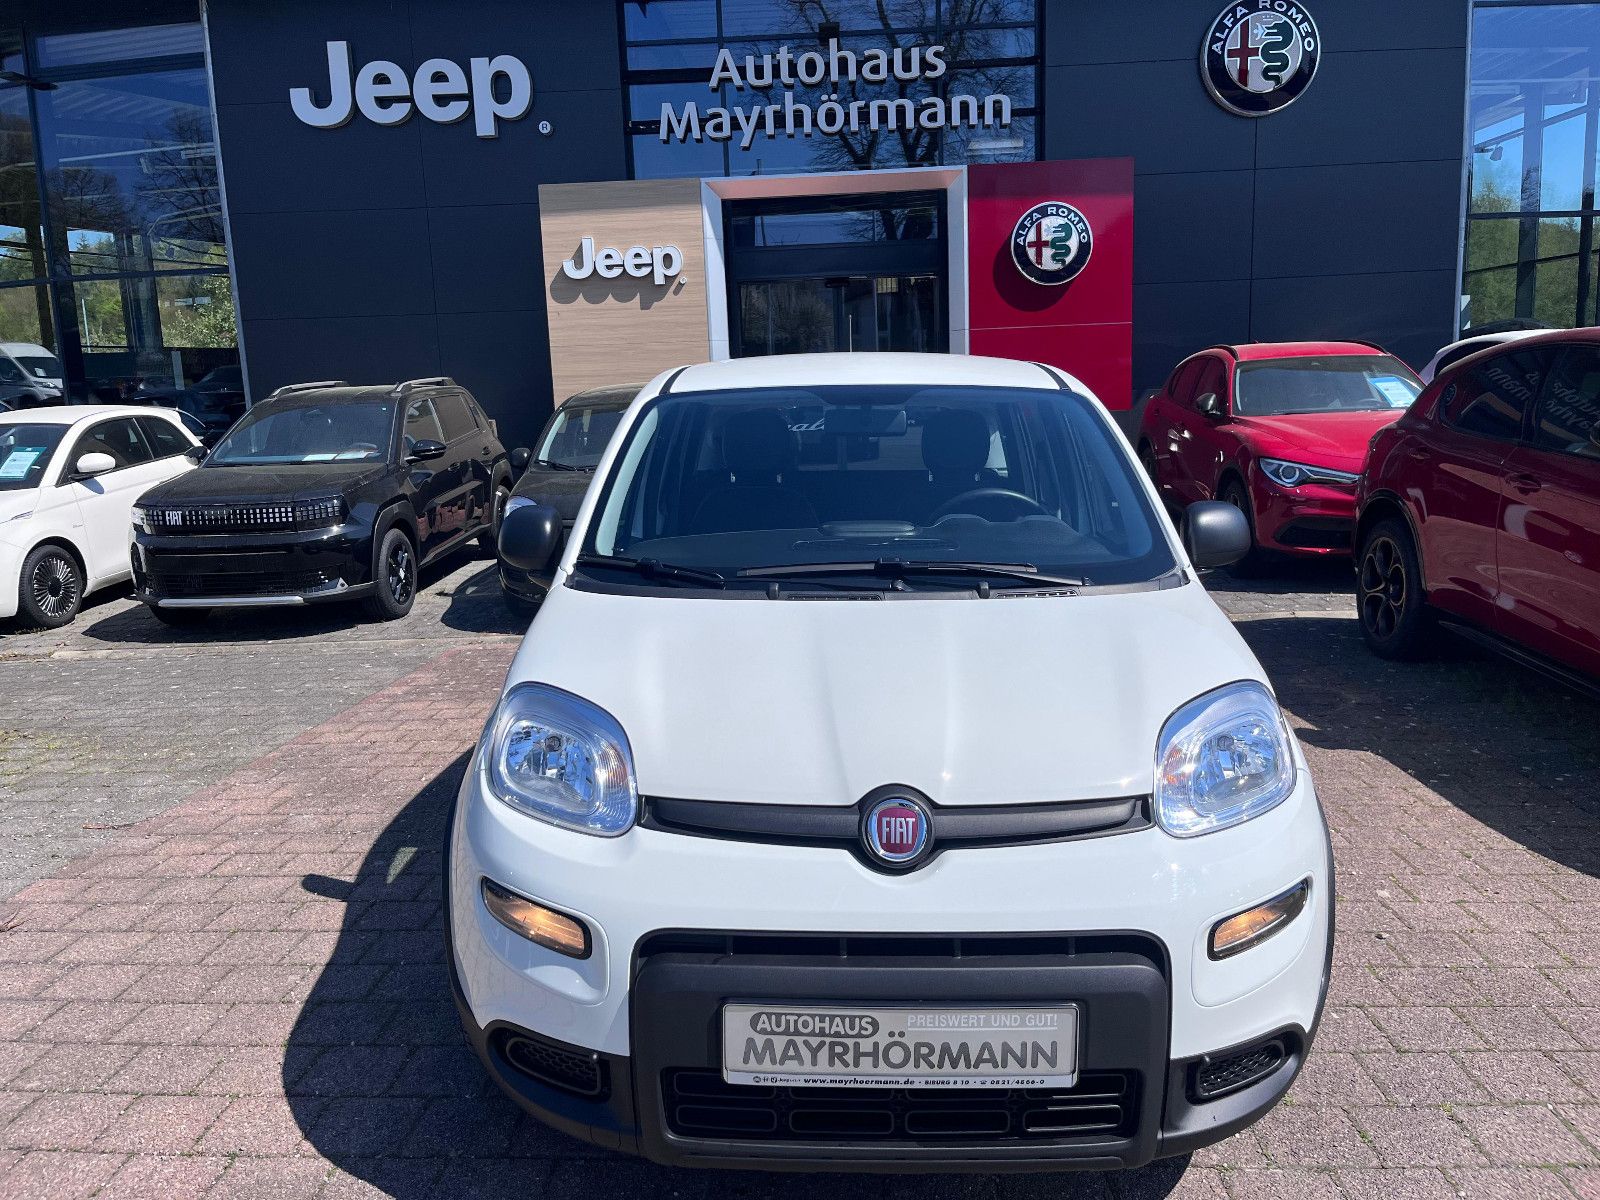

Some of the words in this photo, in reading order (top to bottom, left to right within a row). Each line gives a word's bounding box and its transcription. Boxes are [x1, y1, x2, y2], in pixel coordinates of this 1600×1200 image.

[1211, 5, 1249, 54] ALFA
[1259, 0, 1315, 52] ROMEO
[708, 37, 947, 89] Autohaus
[289, 40, 533, 138] Jeep
[659, 92, 1012, 148] Mayrhörmann
[1016, 212, 1041, 246] ALFA
[1047, 206, 1088, 243] ROMEO
[562, 236, 684, 285] Jeep
[165, 510, 182, 525] FIAT
[881, 816, 915, 844] FIAT
[756, 1013, 874, 1035] AUTOHAUS
[907, 1014, 986, 1027] PREISWERT
[991, 1014, 1021, 1027] UND
[1025, 1013, 1058, 1027] GUT!
[742, 1031, 1058, 1069] MAYRHÖRMANN
[803, 1077, 915, 1087] www.mayrhoermann.de
